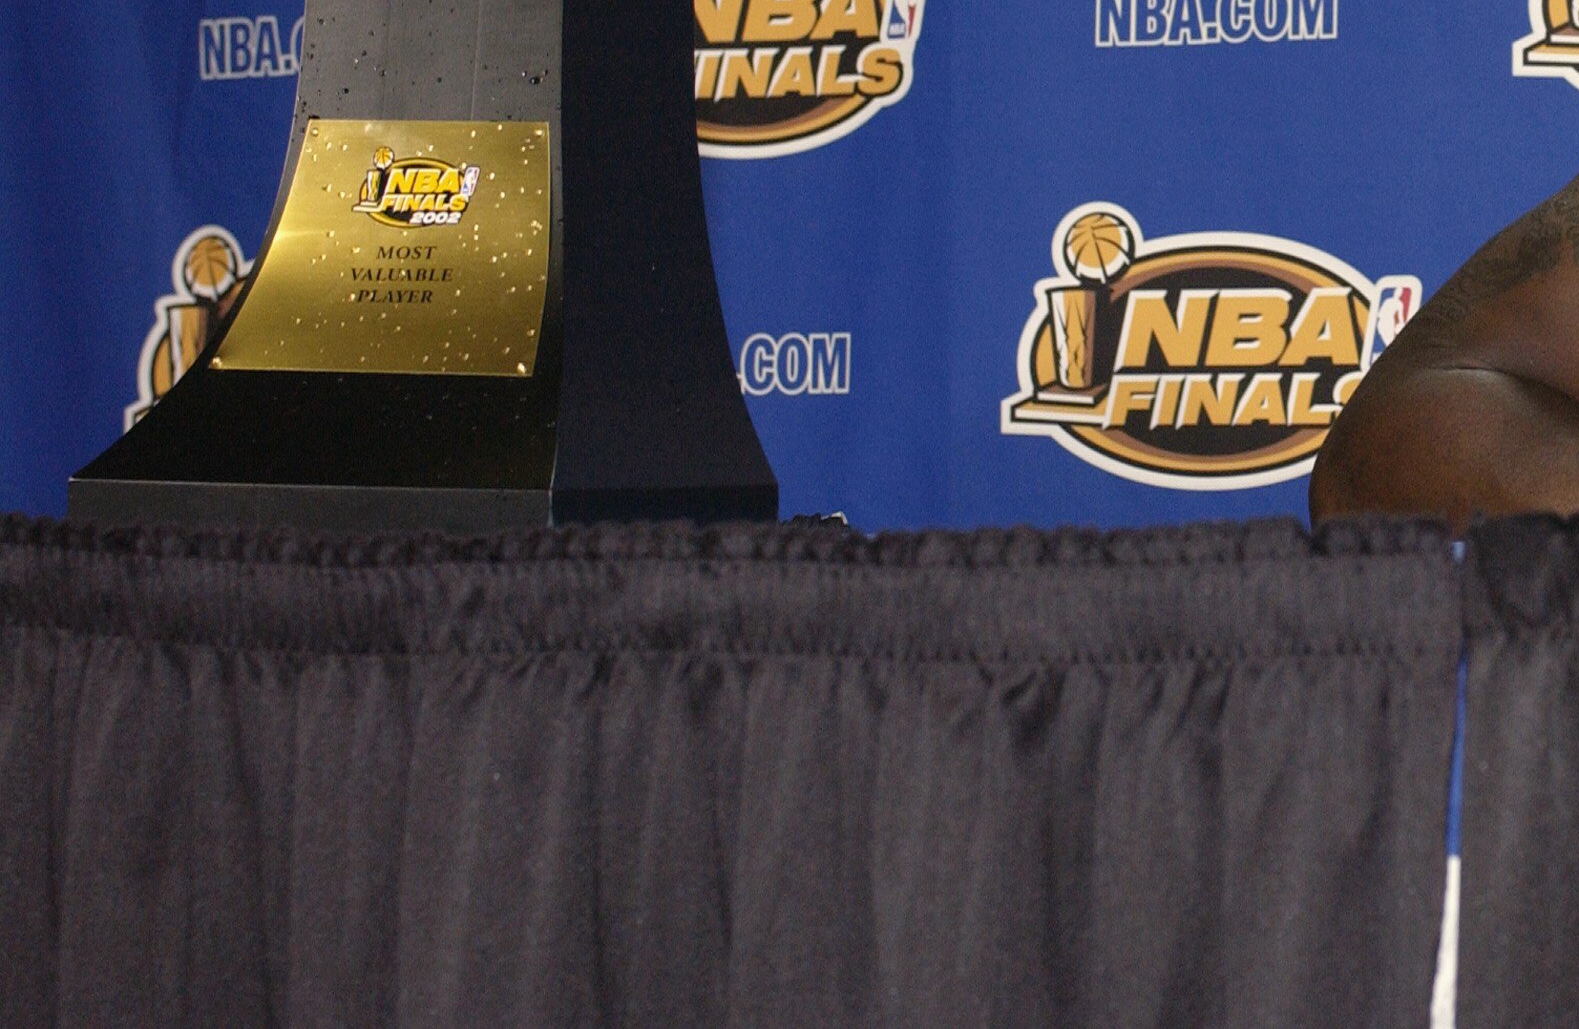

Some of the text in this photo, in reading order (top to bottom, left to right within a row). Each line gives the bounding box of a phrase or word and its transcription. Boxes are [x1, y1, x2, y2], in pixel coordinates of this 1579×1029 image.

[694, 45, 904, 103] INALS
[385, 167, 460, 195] NBA
[380, 193, 468, 212] FINALS
[409, 211, 463, 225] 2002
[376, 245, 438, 260] MOST
[351, 267, 454, 283] VALUABLE
[356, 288, 434, 305] PLAYER
[1114, 286, 1360, 372] NBA
